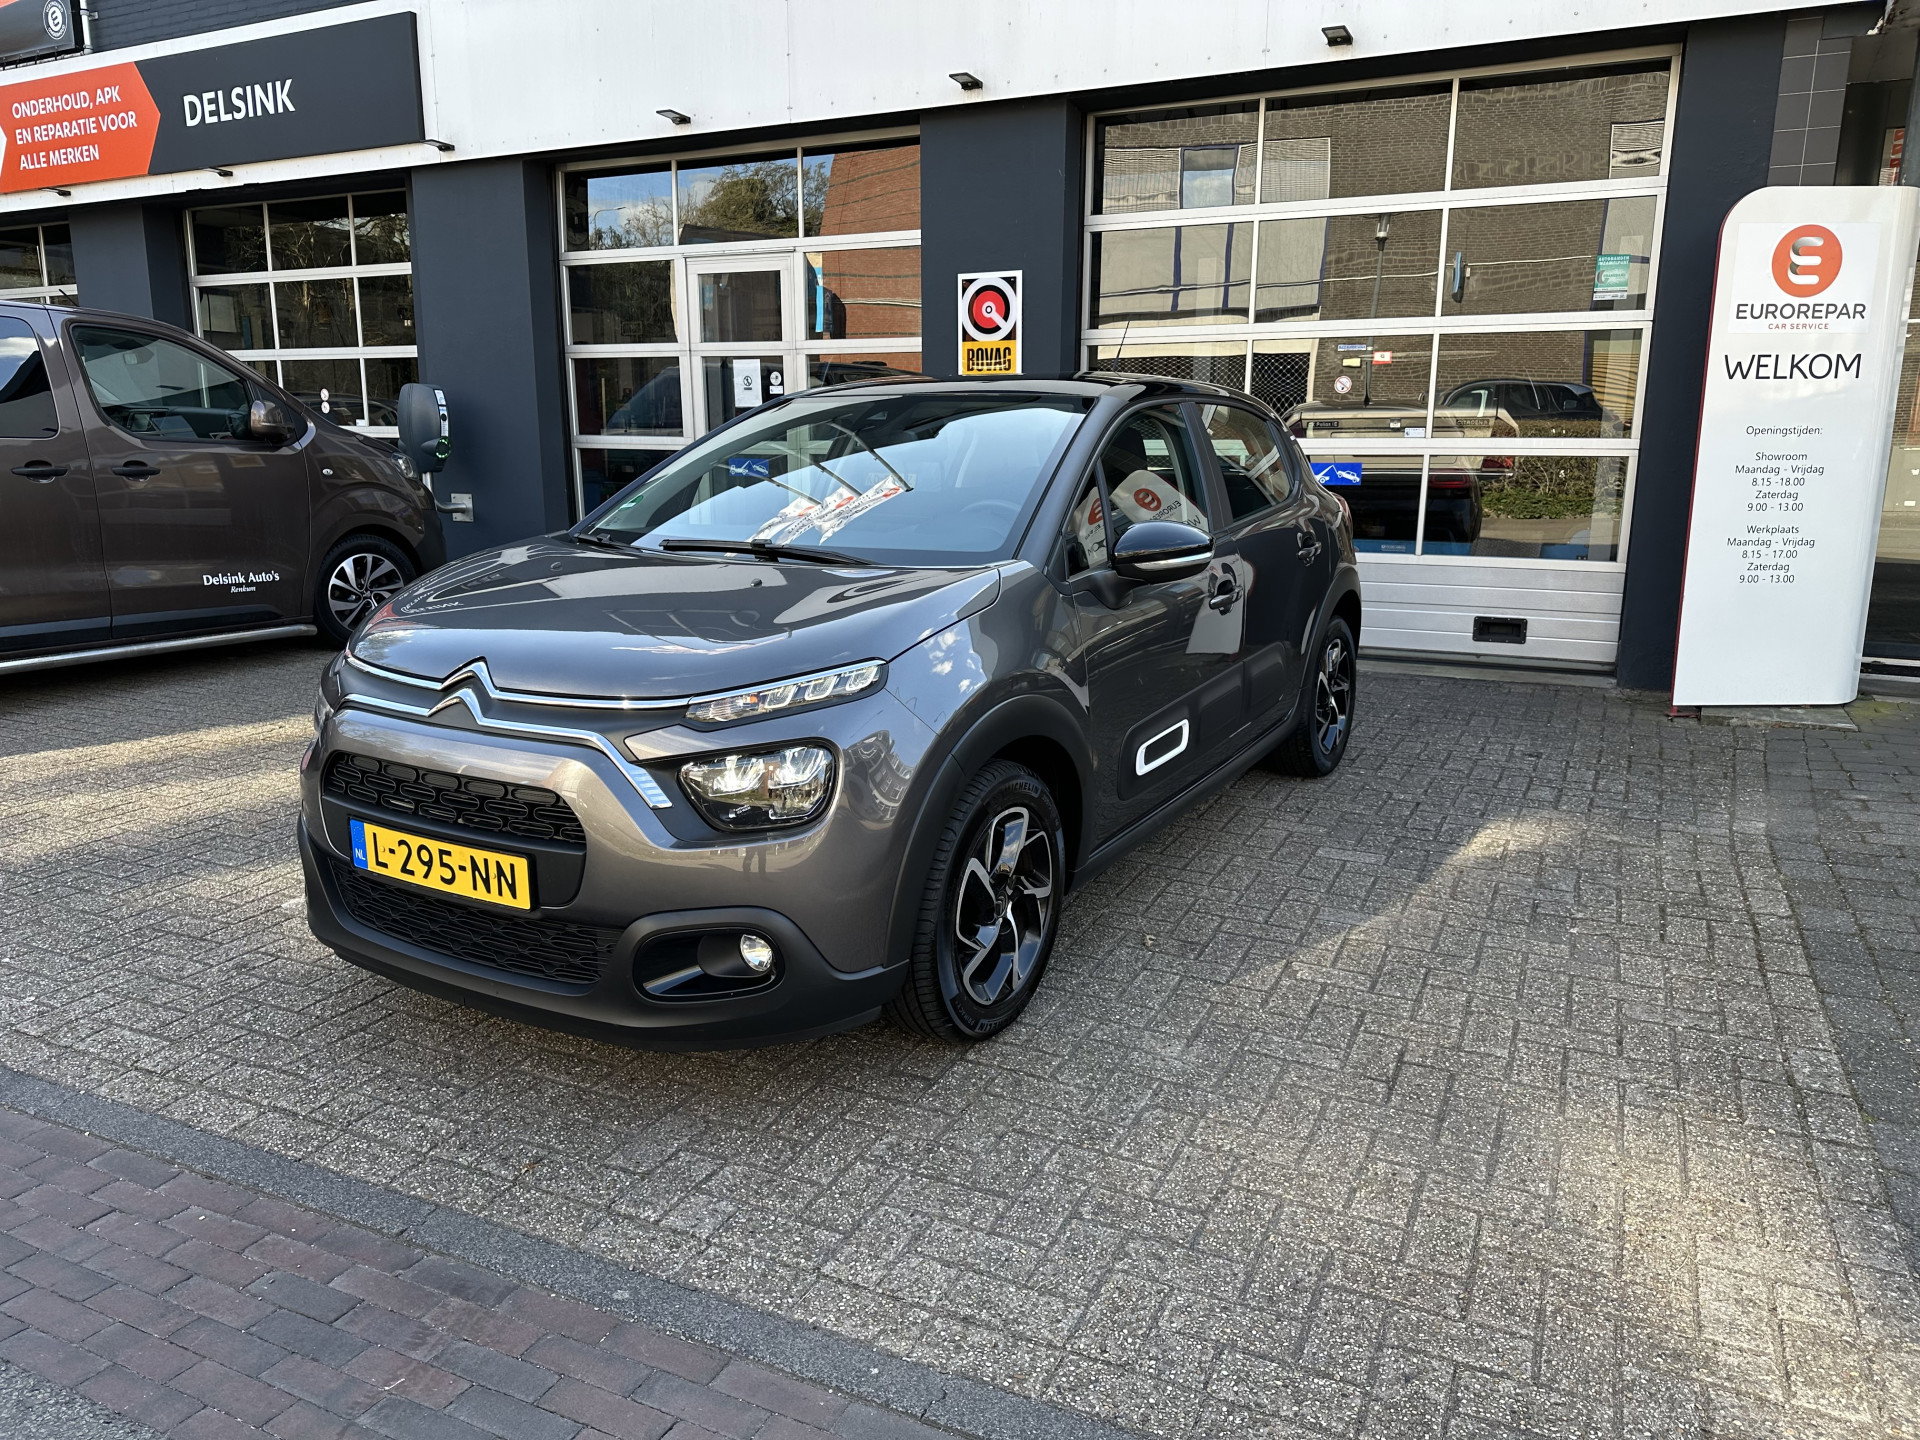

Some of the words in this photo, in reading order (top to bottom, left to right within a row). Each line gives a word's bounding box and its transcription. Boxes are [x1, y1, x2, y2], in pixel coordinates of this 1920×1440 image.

[11, 91, 94, 119] ONDERHOUD,
[95, 85, 122, 106] APK
[182, 78, 297, 127] DELSINK
[15, 127, 33, 145] EN
[33, 117, 98, 142] REPARATIE
[98, 111, 138, 132] VOOR
[19, 151, 48, 171] ALLE
[49, 144, 100, 167] MERKEN
[1735, 303, 1867, 320] EUROREPAR
[966, 346, 1012, 372] BOVAG
[1724, 353, 1862, 380] WELKOM
[1745, 425, 1823, 438] Openingstijden:
[1755, 451, 1808, 461] Showroom
[1734, 465, 1780, 476] Maandag
[1790, 465, 1825, 476] Vrijdag
[1751, 477, 1772, 486] 8.15
[1755, 489, 1799, 501] Zaterdag
[1747, 502, 1768, 512] 9.00
[1777, 502, 1804, 512] 13.00
[1746, 524, 1800, 536] Werkplaats
[1726, 537, 1772, 549] Maandag
[1781, 537, 1816, 549] Vrijdag
[1741, 549, 1762, 559] 8.15
[1772, 549, 1798, 559] 17.00
[1746, 562, 1790, 573] Zaterdag
[202, 572, 247, 586] Delsink
[248, 570, 280, 583] Auto's
[1739, 574, 1759, 584] 9.00
[1769, 574, 1795, 584] 13.00
[230, 585, 256, 594] Renkum
[354, 847, 366, 861] NL
[371, 831, 518, 900] L-295-NN
